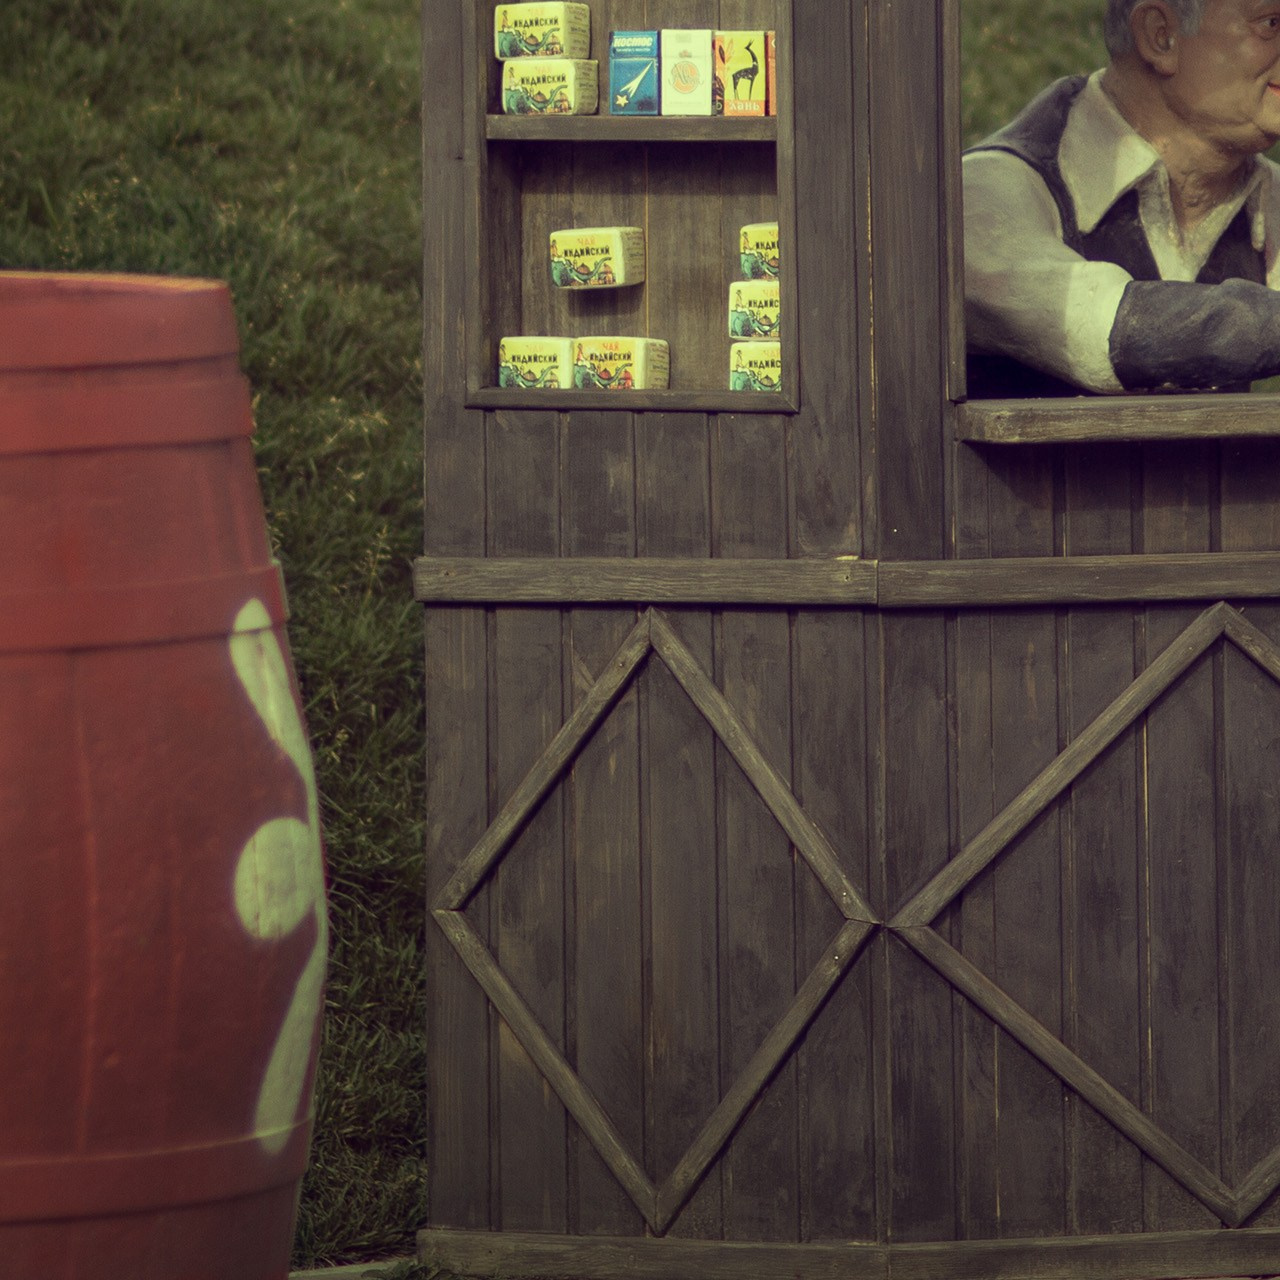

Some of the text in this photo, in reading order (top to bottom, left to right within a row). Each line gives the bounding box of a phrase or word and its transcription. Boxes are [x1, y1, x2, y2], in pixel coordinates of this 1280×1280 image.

[514, 16, 559, 28] ИНДИЙСКИЙ
[613, 36, 653, 47] КОСМОС
[521, 74, 567, 86] ИНДИЙСКИЙ
[564, 245, 610, 258] ИНДИЙСКИЙ
[602, 340, 620, 351] ЧАЙ
[511, 353, 558, 365] ИНДИЙСКИЙ
[590, 351, 632, 363] ИНДИЙСКИЙ
